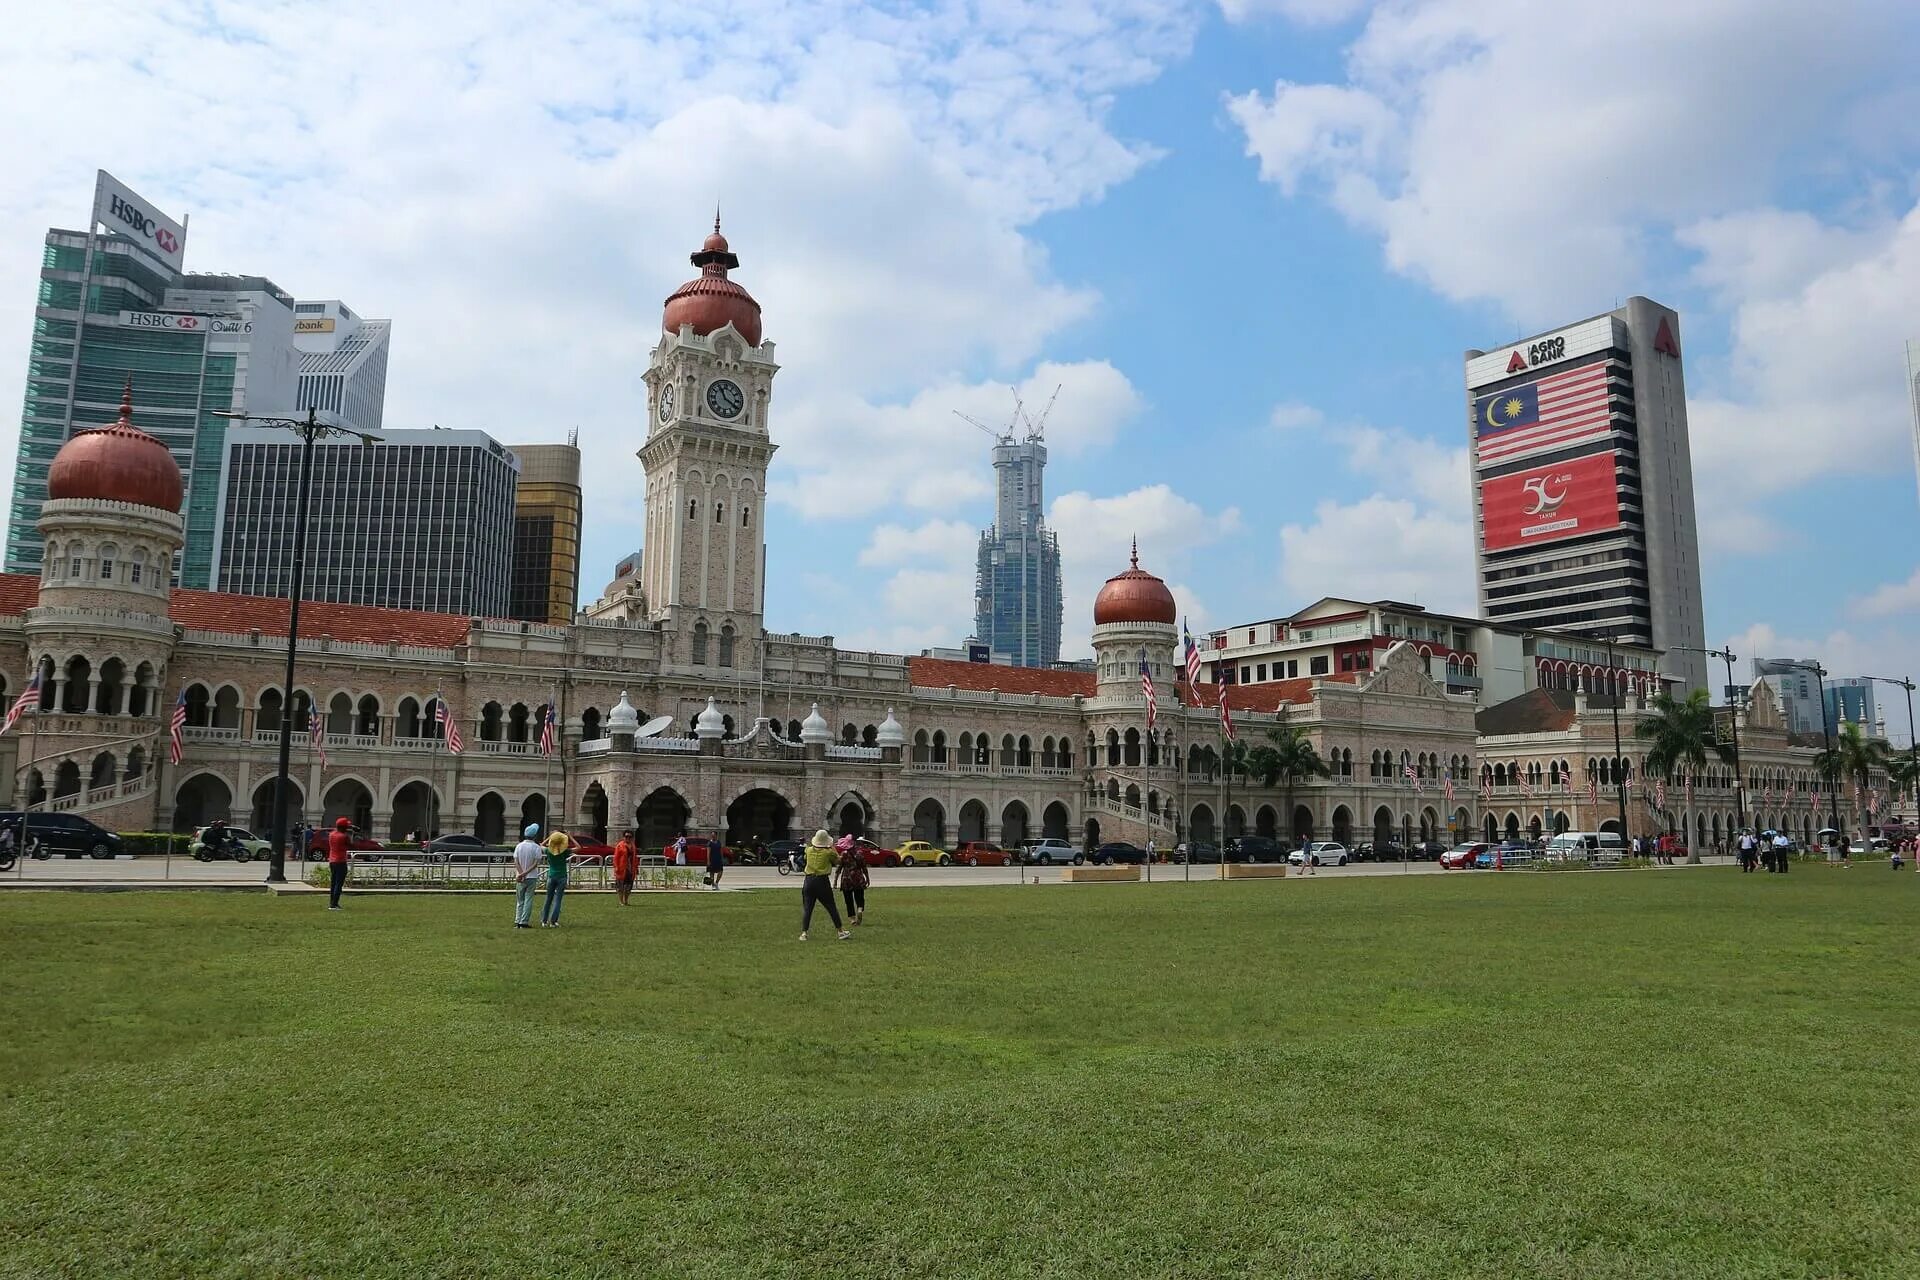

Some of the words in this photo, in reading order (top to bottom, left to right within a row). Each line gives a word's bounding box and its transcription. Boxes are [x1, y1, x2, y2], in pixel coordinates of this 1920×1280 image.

[110, 193, 155, 238] HSBC
[130, 313, 173, 328] HSBC
[244, 321, 252, 333] 6
[1531, 336, 1565, 355] AGRO
[1531, 346, 1566, 366] BANK
